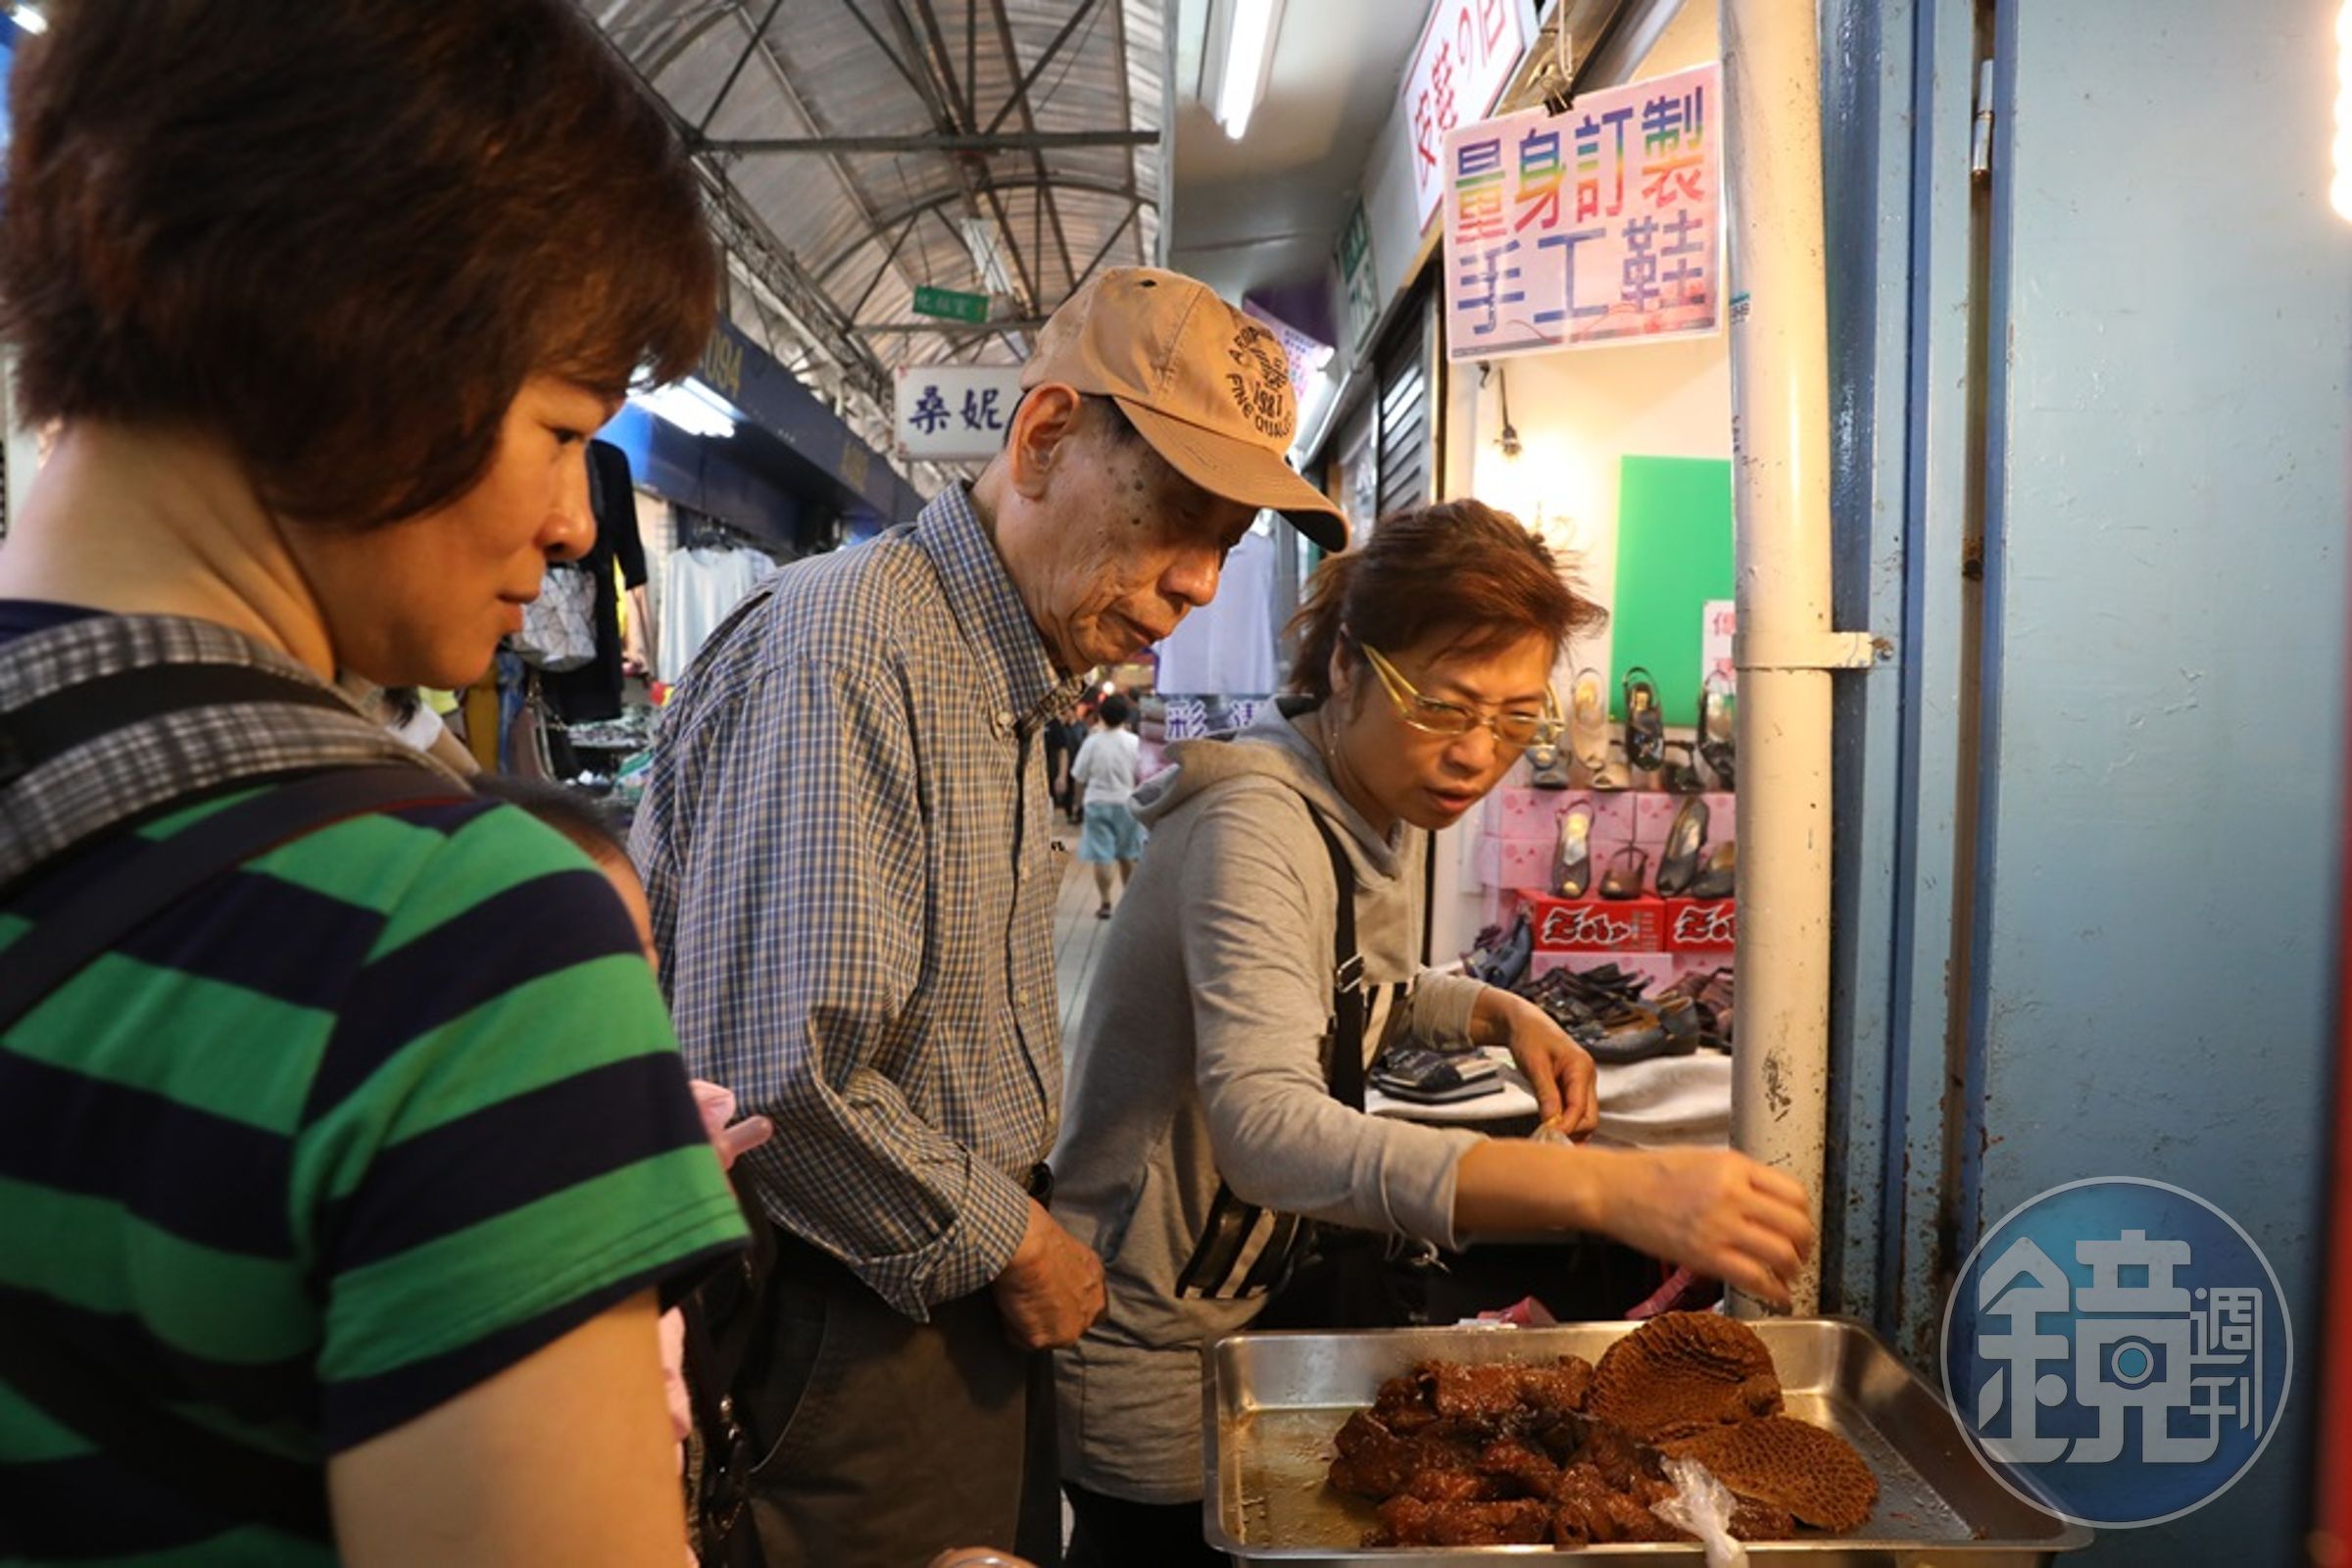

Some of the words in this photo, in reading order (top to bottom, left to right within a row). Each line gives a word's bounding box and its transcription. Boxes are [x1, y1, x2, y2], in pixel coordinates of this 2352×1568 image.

[1455, 86, 1705, 244] 量身訂製
[1457, 209, 1706, 335] 手工鞋
[907, 384, 1004, 435] 桑妮
[1225, 372, 1253, 419] FINE
